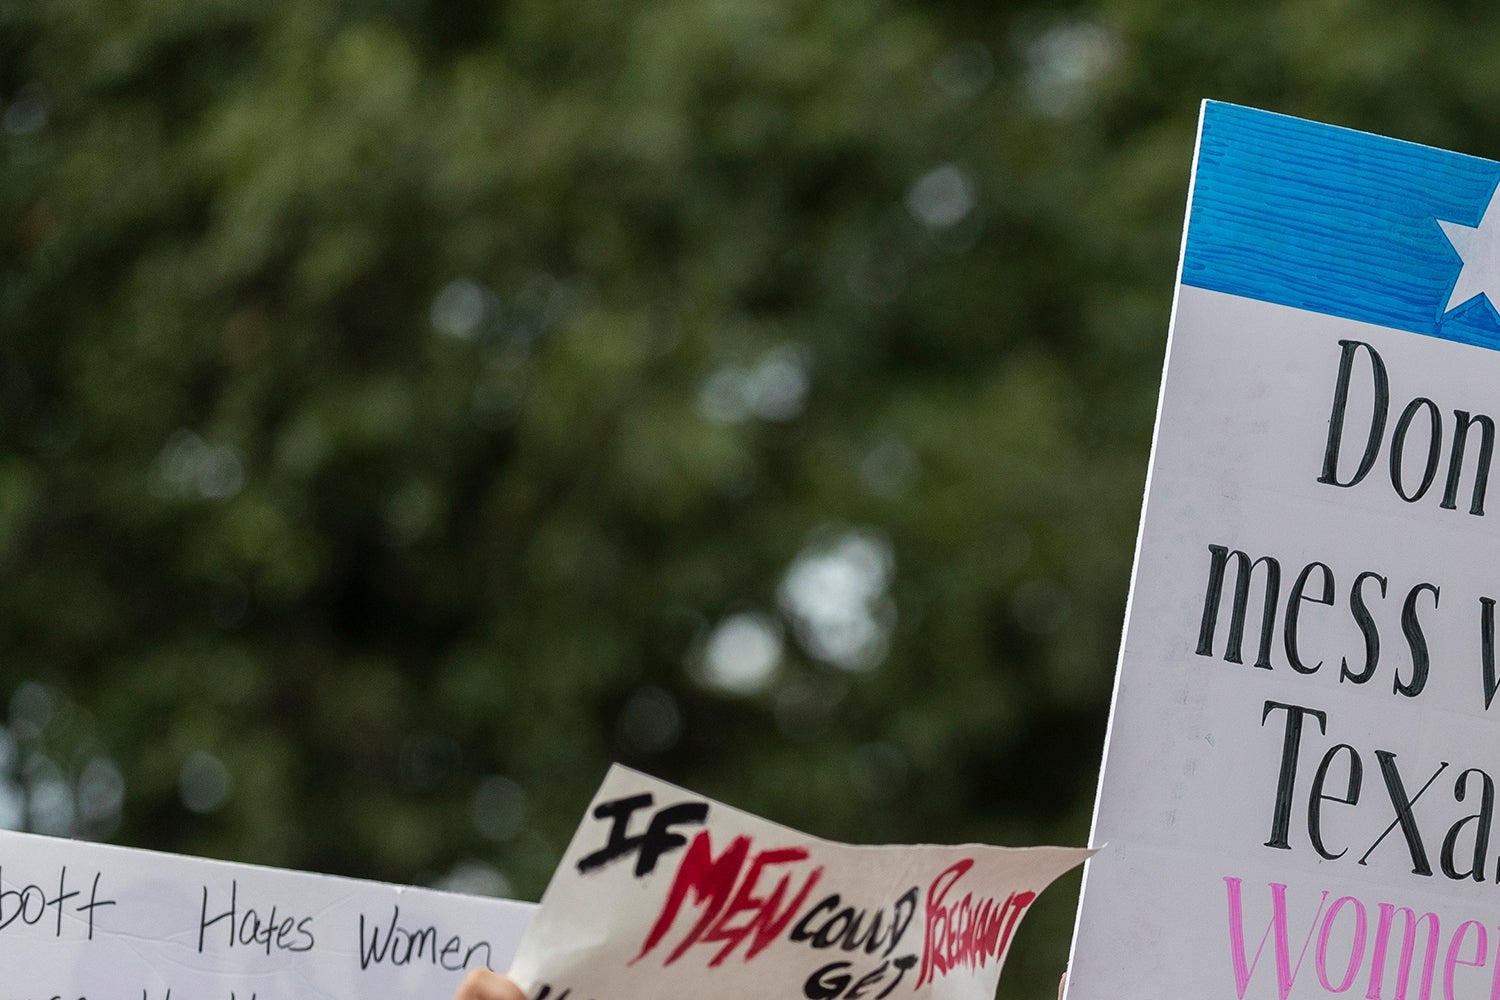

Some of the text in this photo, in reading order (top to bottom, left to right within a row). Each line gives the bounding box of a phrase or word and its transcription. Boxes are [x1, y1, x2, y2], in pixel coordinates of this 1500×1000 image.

[1196, 543, 1441, 698] mess
[199, 880, 315, 955] Hates
[359, 905, 495, 972] Women
[629, 829, 824, 969] MEN
[789, 886, 919, 957] COULD
[914, 858, 1036, 991] PREGNANT
